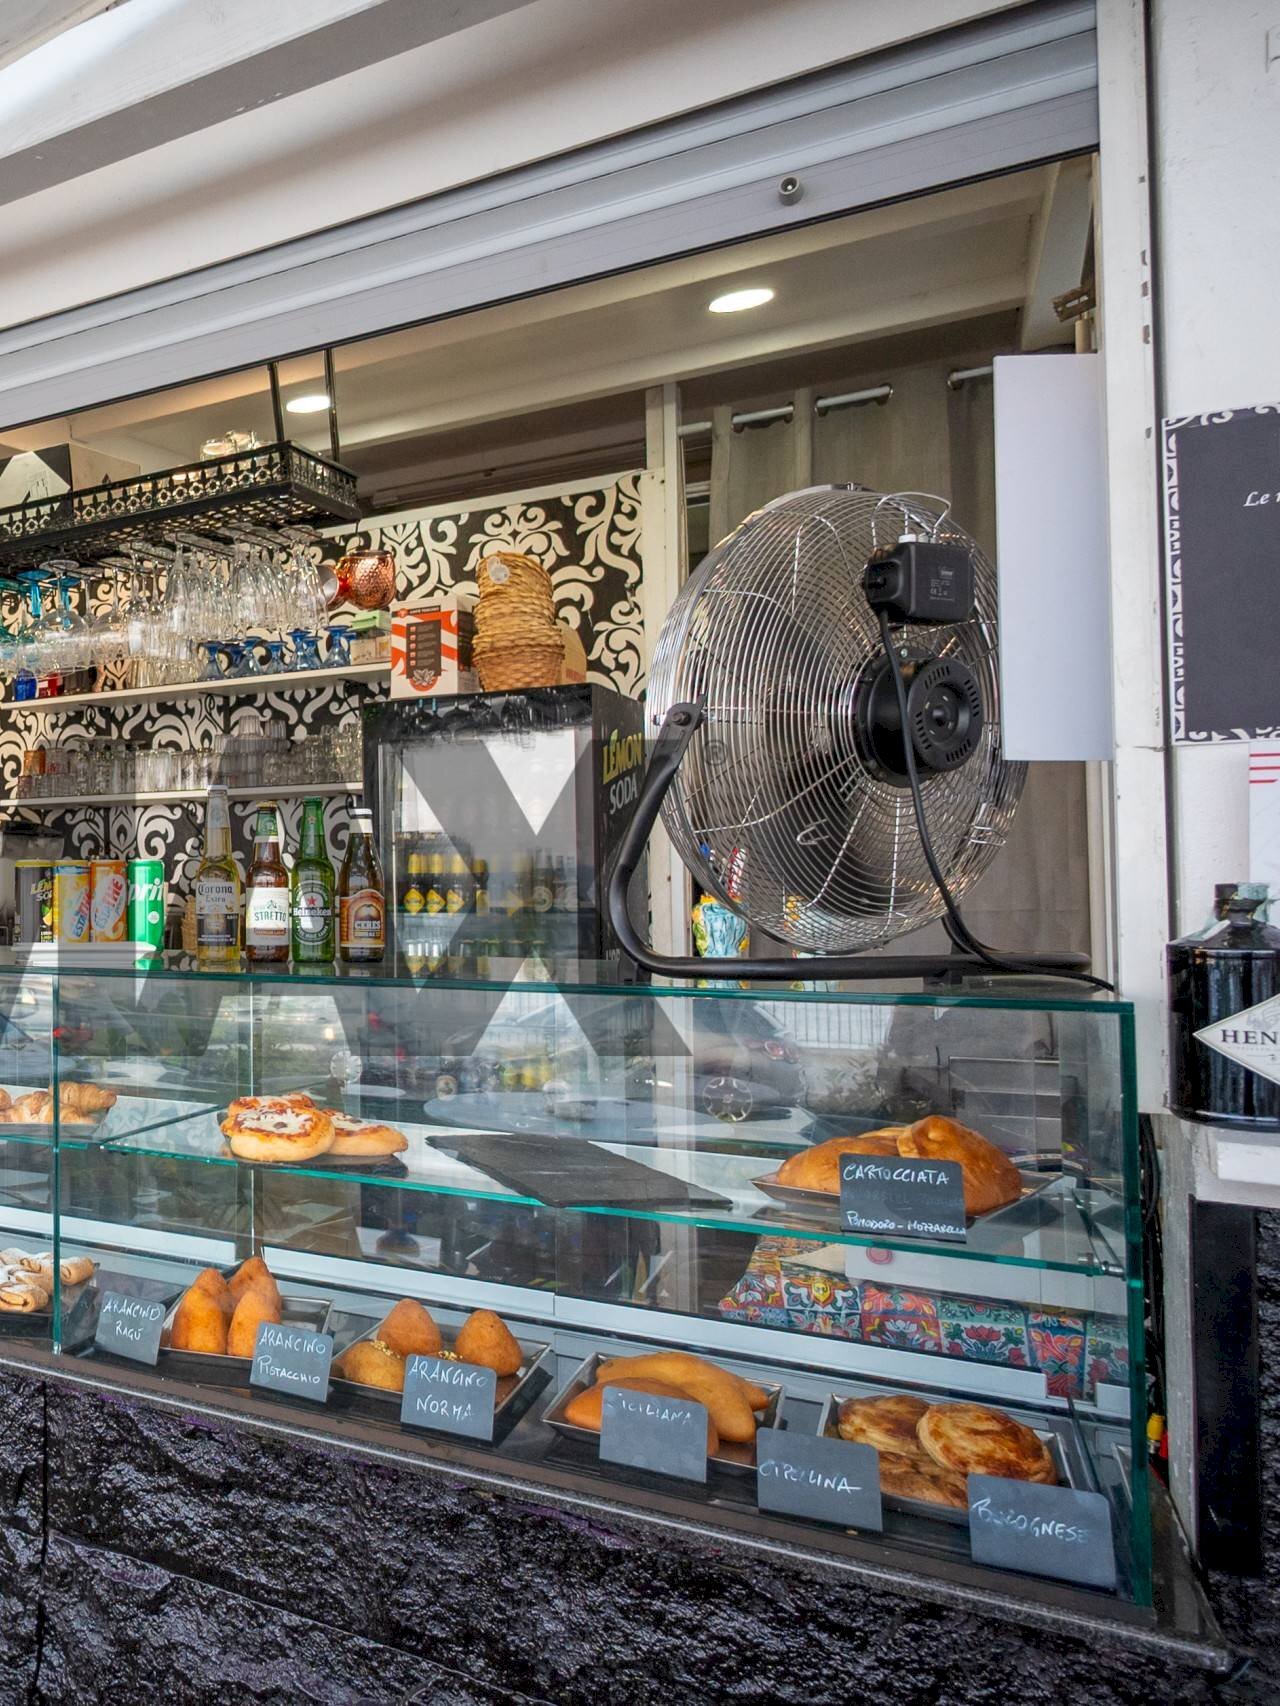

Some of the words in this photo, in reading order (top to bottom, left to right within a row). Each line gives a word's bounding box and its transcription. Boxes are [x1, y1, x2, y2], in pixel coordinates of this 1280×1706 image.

[1243, 491, 1271, 507] Le
[602, 728, 643, 785] LEMON
[610, 772, 638, 815] SODA
[197, 883, 234, 896] Corona
[254, 911, 287, 922] STRETTO
[293, 907, 332, 916] Heineken
[1220, 1029, 1278, 1046] HEN
[842, 1162, 950, 1185] CARTOCCIATA
[102, 1298, 161, 1321] ARANCINO
[258, 1325, 326, 1354] ARANCINO
[257, 1354, 321, 1384] PISTACCHIO
[407, 1355, 489, 1388] ARANCINO
[416, 1393, 473, 1420] NORMA
[607, 1392, 692, 1425] ICILIANA
